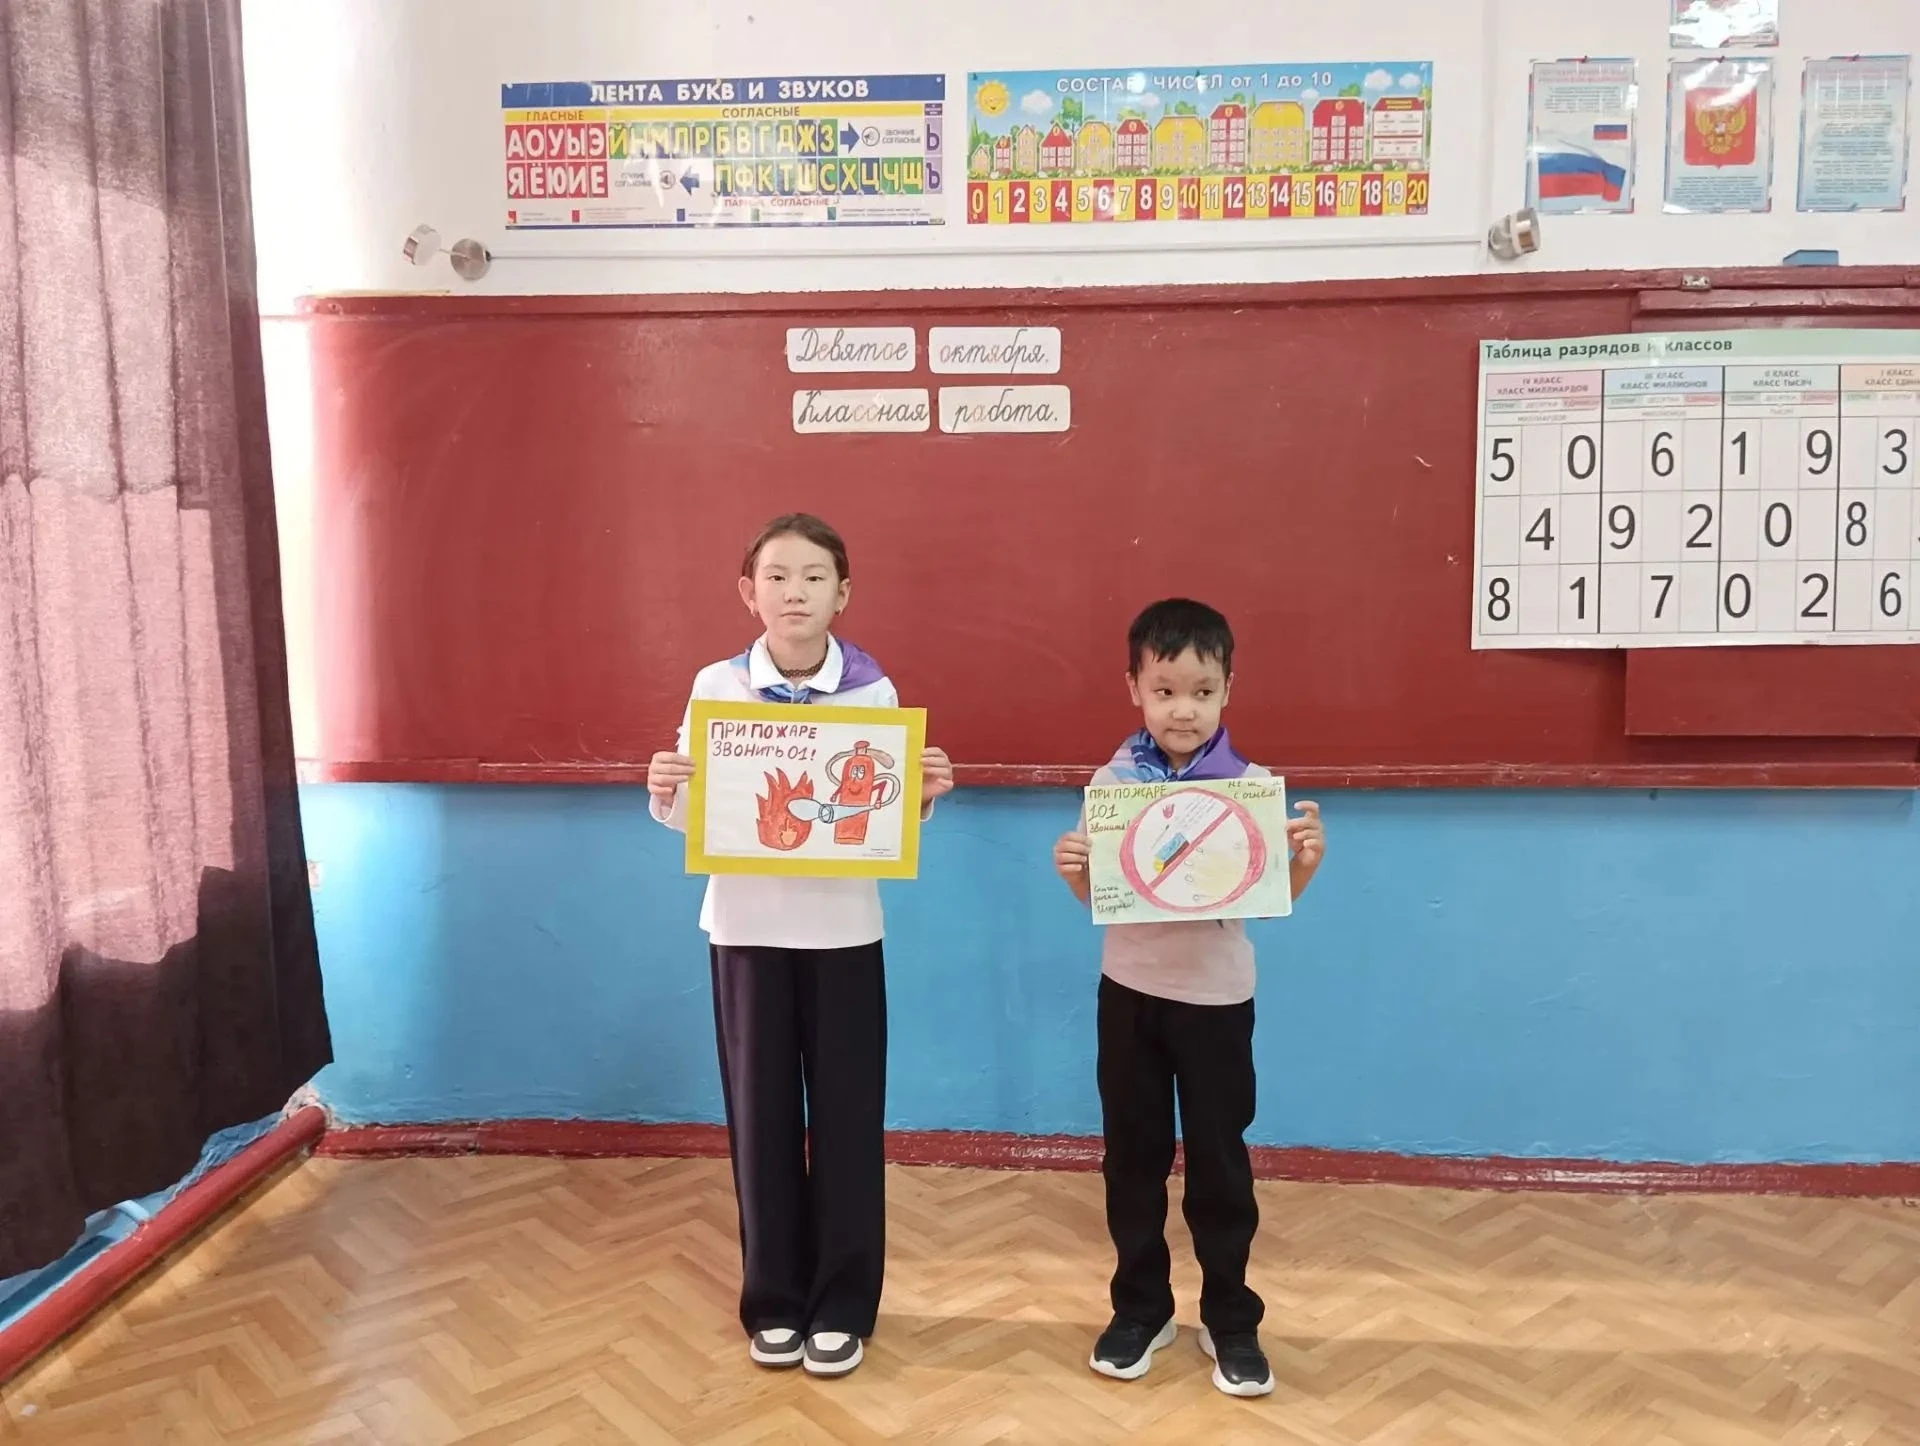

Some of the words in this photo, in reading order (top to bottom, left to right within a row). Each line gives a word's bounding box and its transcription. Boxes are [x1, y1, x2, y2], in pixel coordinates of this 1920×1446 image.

[1231, 75, 1251, 88] от
[1261, 72, 1269, 86] 1
[1277, 76, 1302, 89] до
[1311, 71, 1332, 86] 10
[590, 83, 664, 103] ЛЕНТА
[677, 81, 734, 101] БУКВ
[749, 82, 764, 100] И
[778, 80, 869, 99] ЗВУКОВ
[526, 110, 585, 121] ГЛАСНЫЕ
[722, 105, 800, 118] СОГЛАСНЫЕ
[724, 199, 764, 208] ПАР
[971, 189, 984, 213] 0
[993, 189, 1004, 213] 1
[1013, 187, 1026, 212] 2
[1034, 186, 1047, 212] 3
[1054, 187, 1068, 212] 4
[1076, 186, 1090, 211] 5
[1098, 185, 1111, 210] 6
[1119, 185, 1132, 211] 7
[1140, 185, 1152, 210] 8
[1160, 184, 1174, 210] 9
[1180, 184, 1198, 208] 10
[1203, 184, 1219, 209] 11
[1224, 182, 1244, 208] 12
[1247, 182, 1267, 208] 13
[1270, 181, 1290, 208] 14
[1293, 181, 1312, 207] 15
[1316, 181, 1335, 207] 16
[1339, 180, 1359, 206] 17
[1363, 180, 1382, 206] 18
[1385, 180, 1405, 205] 19
[1407, 179, 1427, 205] 20
[796, 328, 909, 363] Девятое
[940, 328, 1050, 373] октября.
[1486, 344, 1552, 359] Таблица
[1559, 342, 1640, 359] разрядов
[1665, 340, 1732, 352] классов
[798, 389, 930, 425] Классная
[952, 388, 1059, 432] работа.
[1489, 437, 1515, 482] 5
[1567, 434, 1596, 480] 0
[1651, 431, 1675, 477] 6
[1731, 431, 1747, 475] 1
[1806, 429, 1833, 475] 9
[1882, 428, 1908, 475] 3
[1525, 507, 1555, 551] 4
[1608, 504, 1635, 549] 9
[1685, 504, 1713, 548] 2
[1764, 502, 1792, 547] 0
[1845, 501, 1867, 546] 8
[1487, 577, 1511, 621] 8
[1569, 576, 1586, 619] 1
[1650, 575, 1673, 618] 7
[1723, 573, 1751, 618] 0
[1800, 573, 1829, 617] 2
[1879, 572, 1902, 617] 6
[711, 721, 746, 740] ПРИ
[751, 723, 818, 739] ПОЖАРЕ
[712, 740, 784, 758] ЗВОНИТЬ
[1089, 789, 1110, 799] ПРИ
[1114, 784, 1168, 799] ПОЖАРЕ
[1088, 803, 1119, 822] 101
